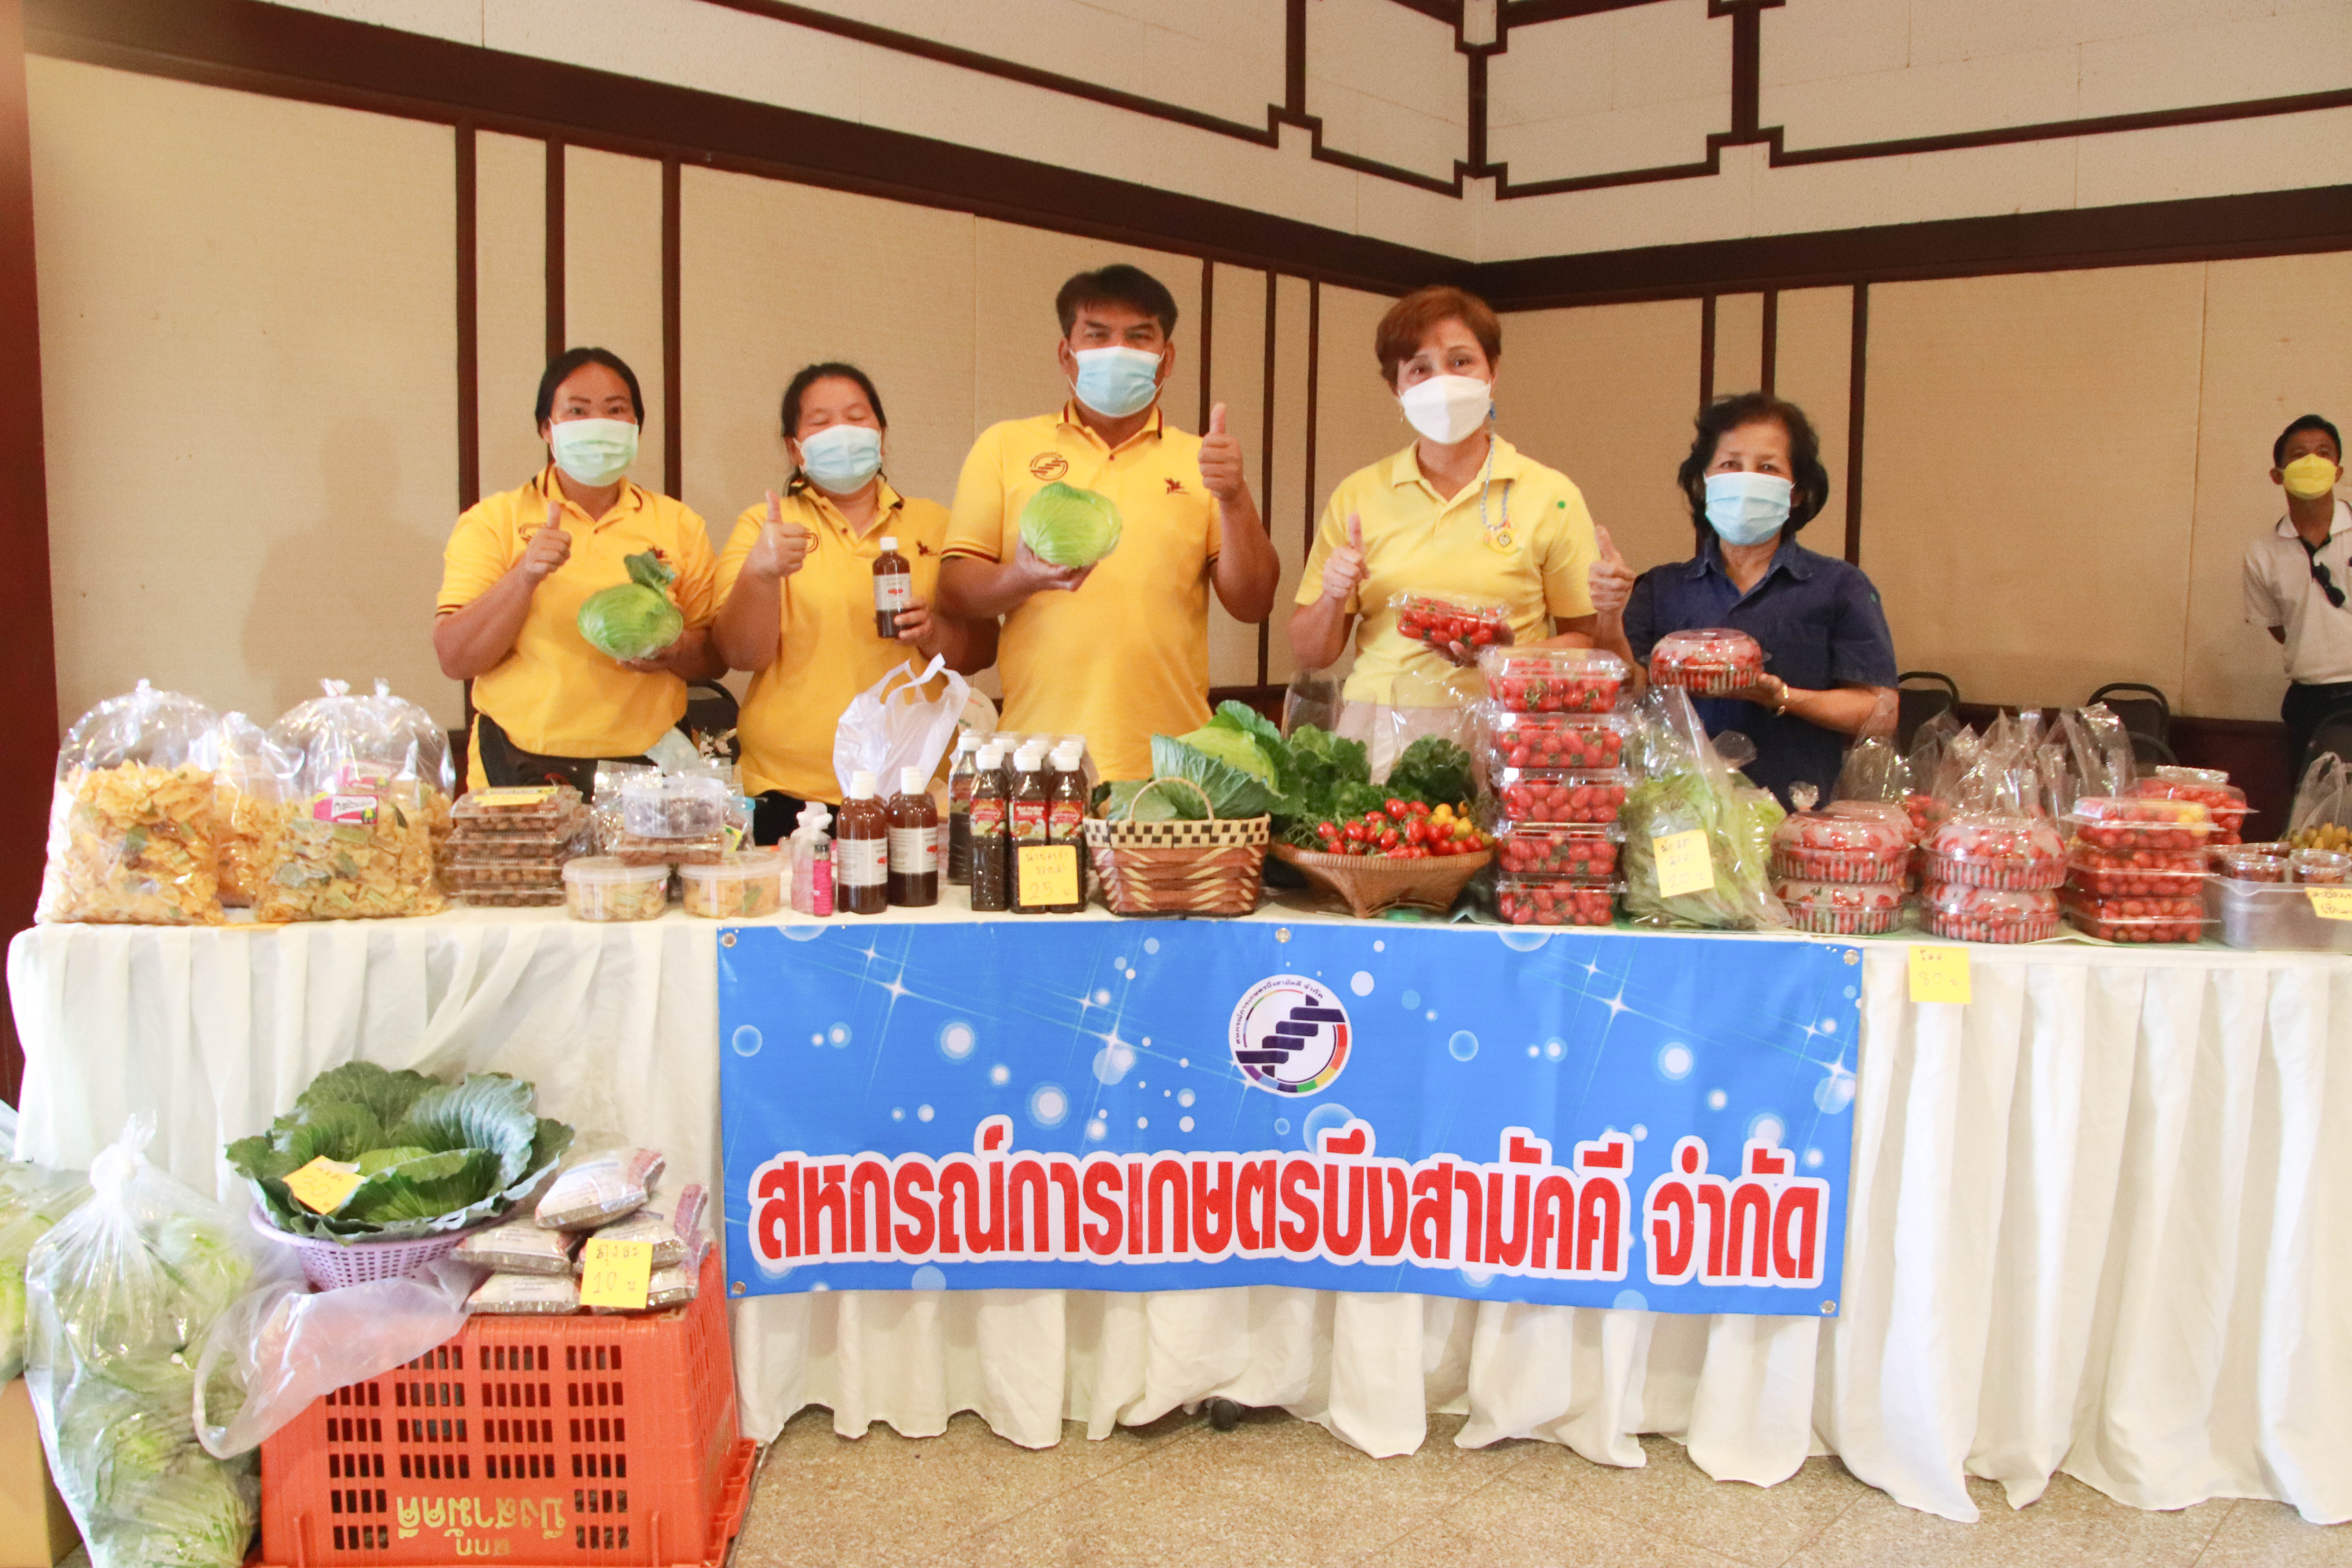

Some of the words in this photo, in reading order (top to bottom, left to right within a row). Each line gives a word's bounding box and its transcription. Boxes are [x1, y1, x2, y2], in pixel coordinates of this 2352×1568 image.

[1029, 881, 1054, 900] 25
[1668, 873, 1691, 888] 20
[1918, 971, 1943, 985] 80
[293, 1174, 331, 1196] 30
[758, 1124, 1623, 1272] สหกรณ์การเกษตรบึงสามัคคี
[1653, 1145, 1820, 1279] จำกัด
[596, 1244, 640, 1267] ถุงละ
[593, 1271, 617, 1294] 10
[397, 1496, 567, 1539] บึงสามัคคี
